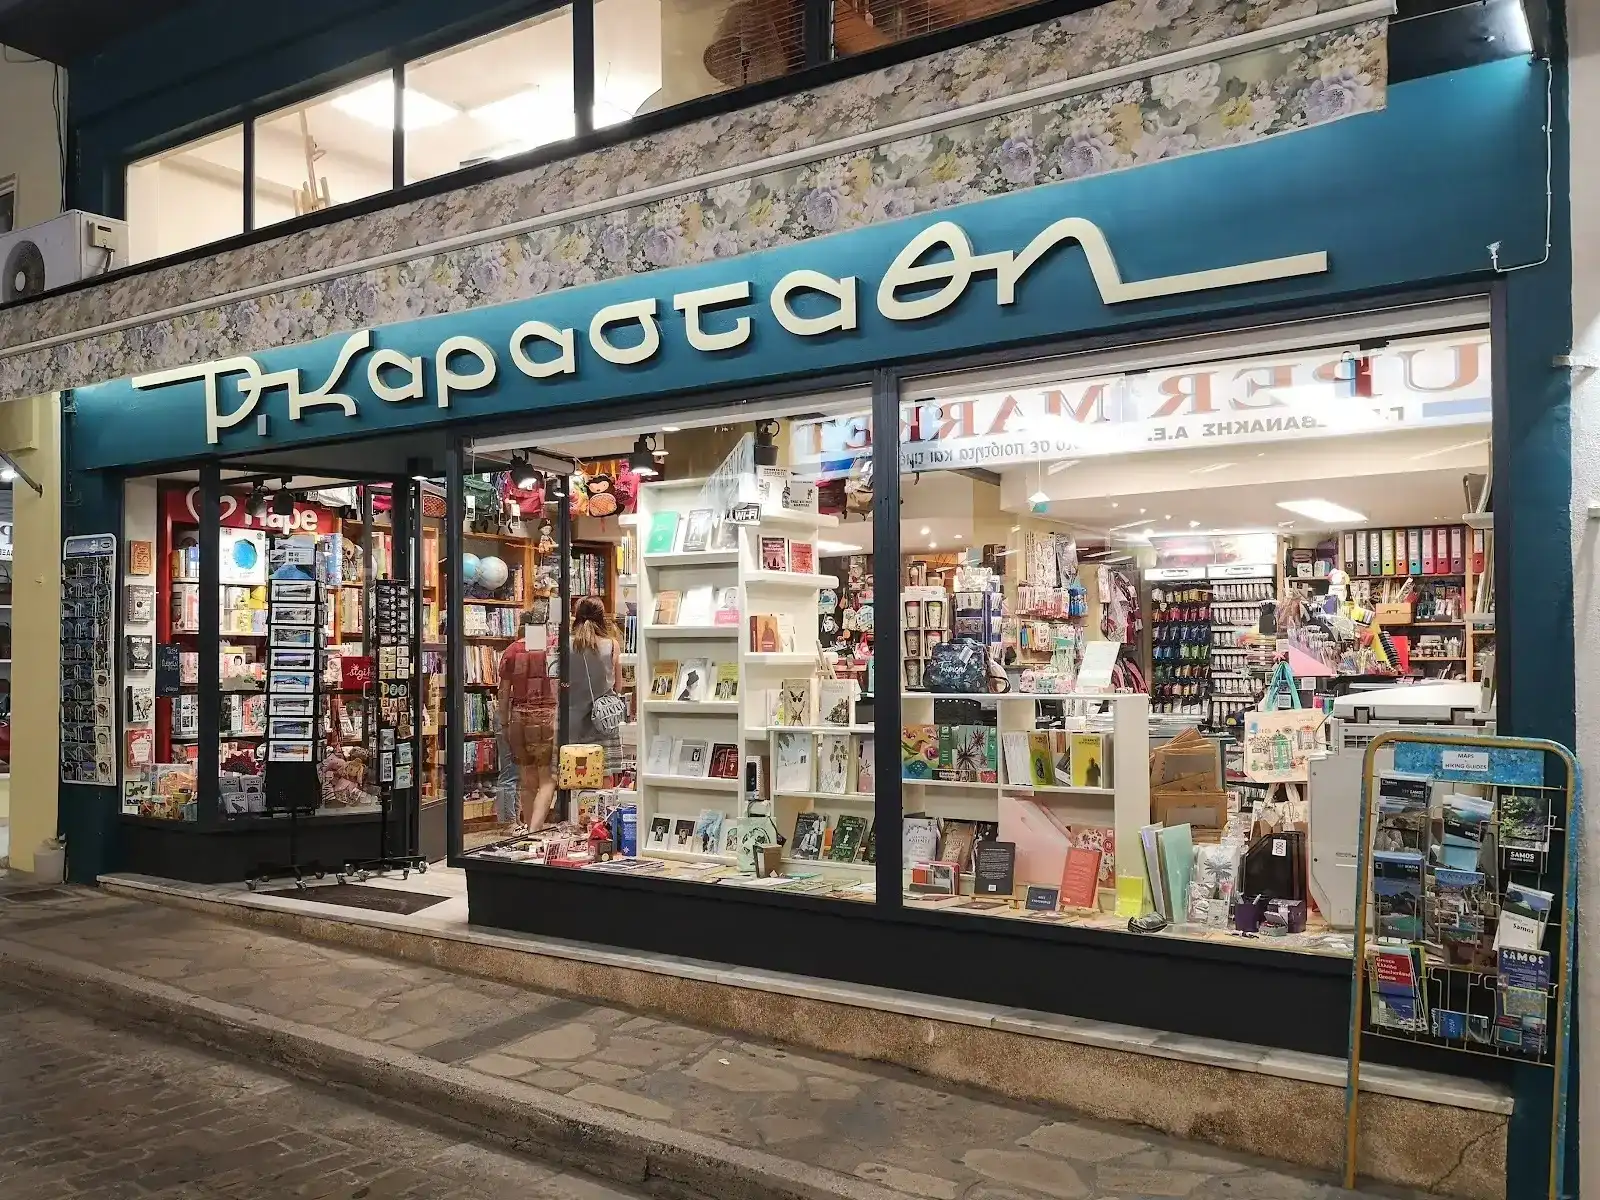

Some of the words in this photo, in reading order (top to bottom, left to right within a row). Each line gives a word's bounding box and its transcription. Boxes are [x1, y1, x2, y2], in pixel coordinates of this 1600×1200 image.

[1510, 851, 1535, 860] SAMOS
[1512, 923, 1535, 934] Samos
[1502, 950, 1545, 965] SAMOS
